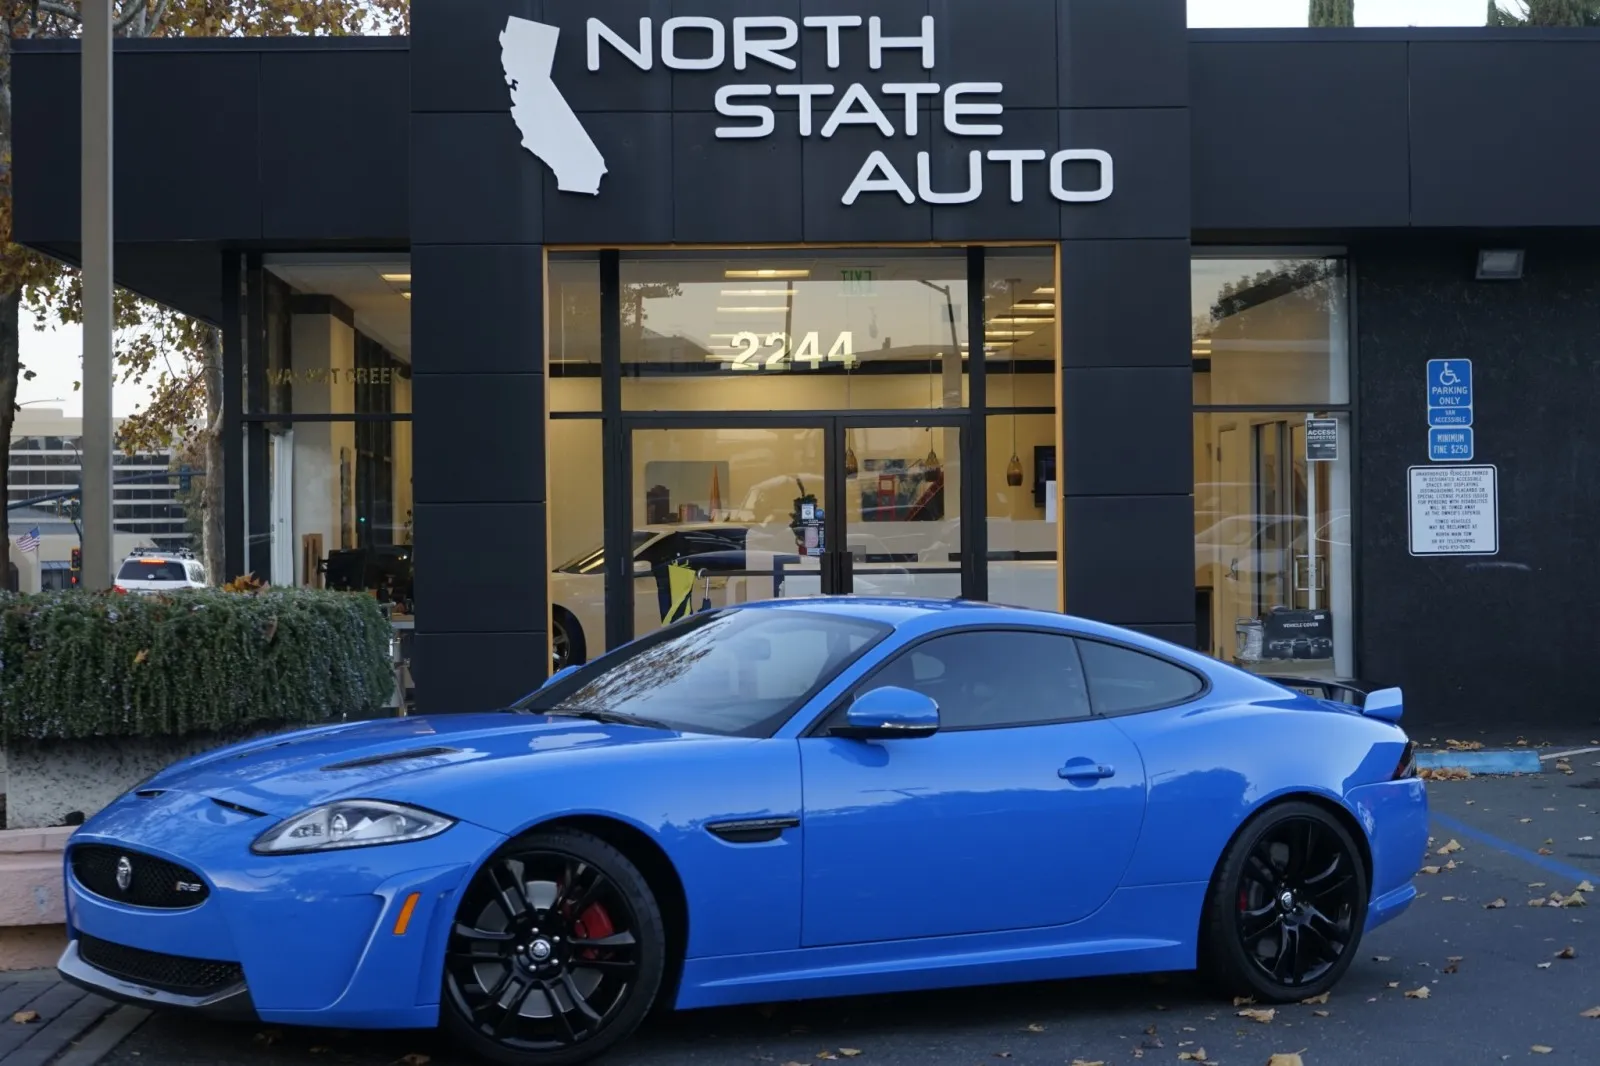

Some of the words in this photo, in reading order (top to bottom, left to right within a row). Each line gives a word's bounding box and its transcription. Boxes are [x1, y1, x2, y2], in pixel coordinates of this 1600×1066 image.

[586, 15, 935, 71] NORTH
[714, 82, 1004, 138] STATE
[841, 148, 1114, 205] AUTO
[731, 331, 857, 371] 2244
[266, 368, 341, 385] WANT
[1432, 386, 1468, 395] PARKING
[1439, 396, 1460, 404] ONLY
[1437, 434, 1464, 442] MINIMUM
[1434, 445, 1448, 454] FINE
[1451, 444, 1468, 454] $250
